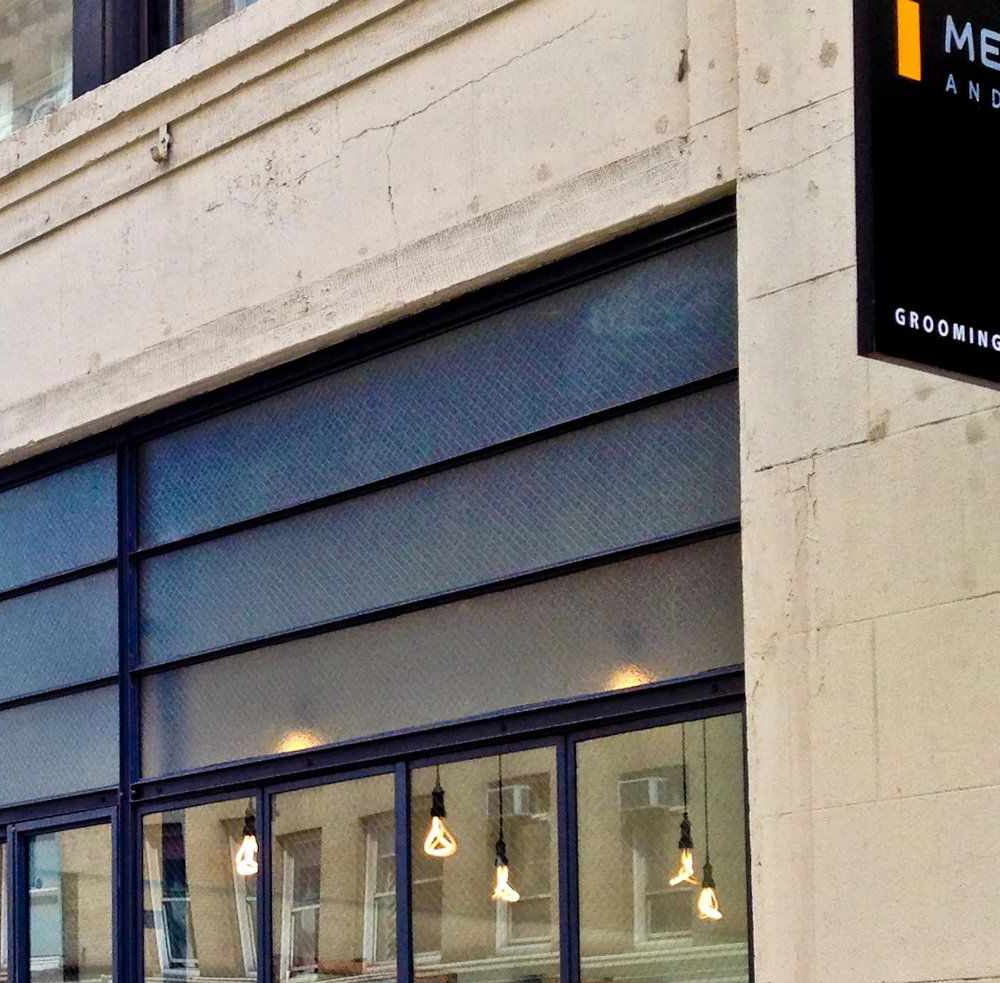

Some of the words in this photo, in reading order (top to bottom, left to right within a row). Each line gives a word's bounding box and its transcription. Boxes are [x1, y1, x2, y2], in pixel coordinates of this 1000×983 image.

[944, 14, 1000, 72] ME
[945, 73, 1000, 109] AND
[894, 307, 1000, 352] GROOMING
